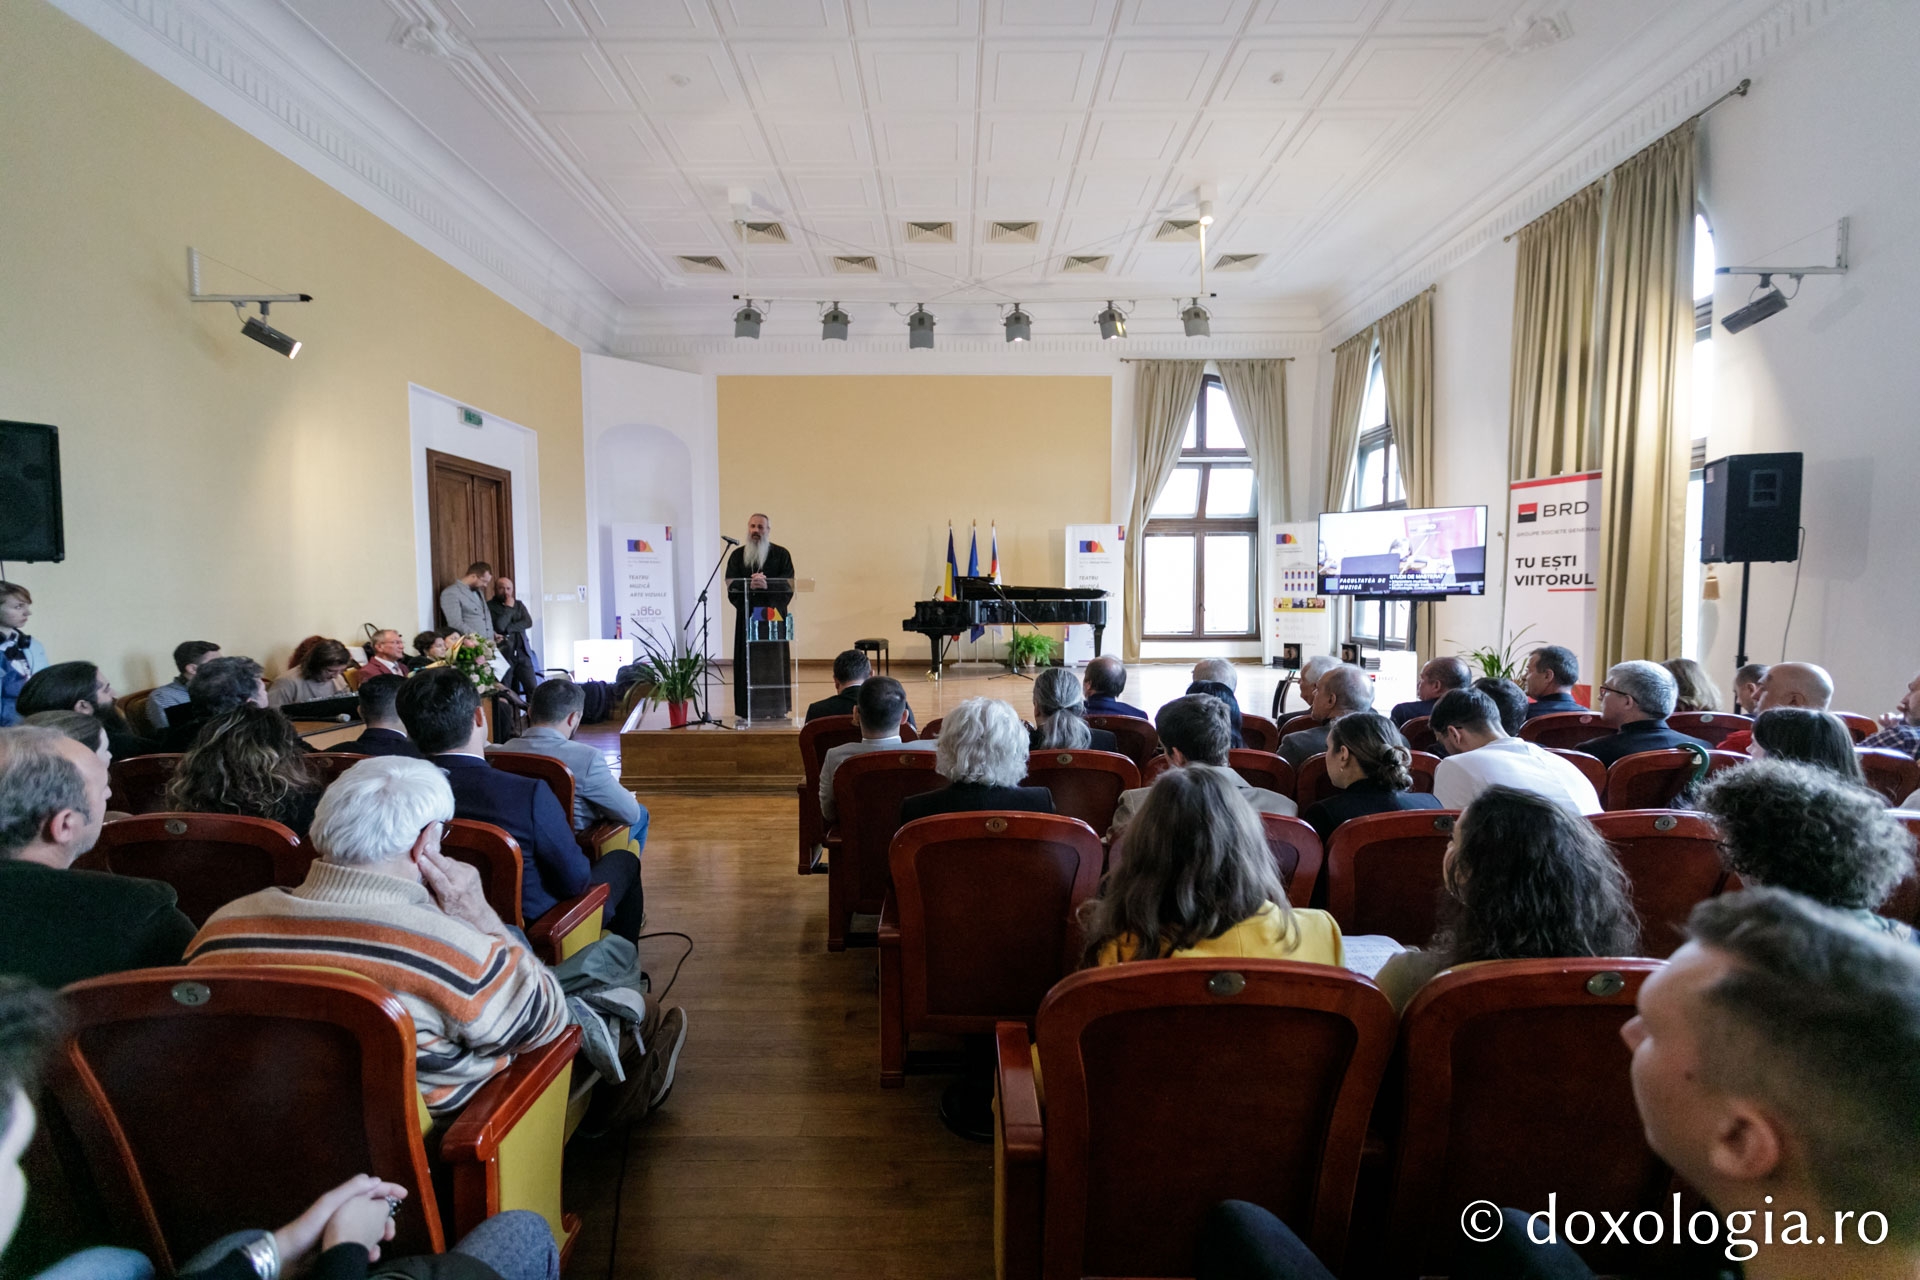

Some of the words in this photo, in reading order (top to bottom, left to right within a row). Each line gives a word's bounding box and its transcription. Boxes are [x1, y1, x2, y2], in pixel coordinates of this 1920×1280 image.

[1543, 501, 1590, 517] BRD
[1515, 557, 1536, 569] TU
[1541, 555, 1577, 571] EȘTI
[1514, 573, 1594, 586] VIITORUL
[992, 819, 1000, 829] 6
[1662, 819, 1670, 827] 9
[1602, 978, 1614, 992] 7
[186, 988, 199, 1003] 5
